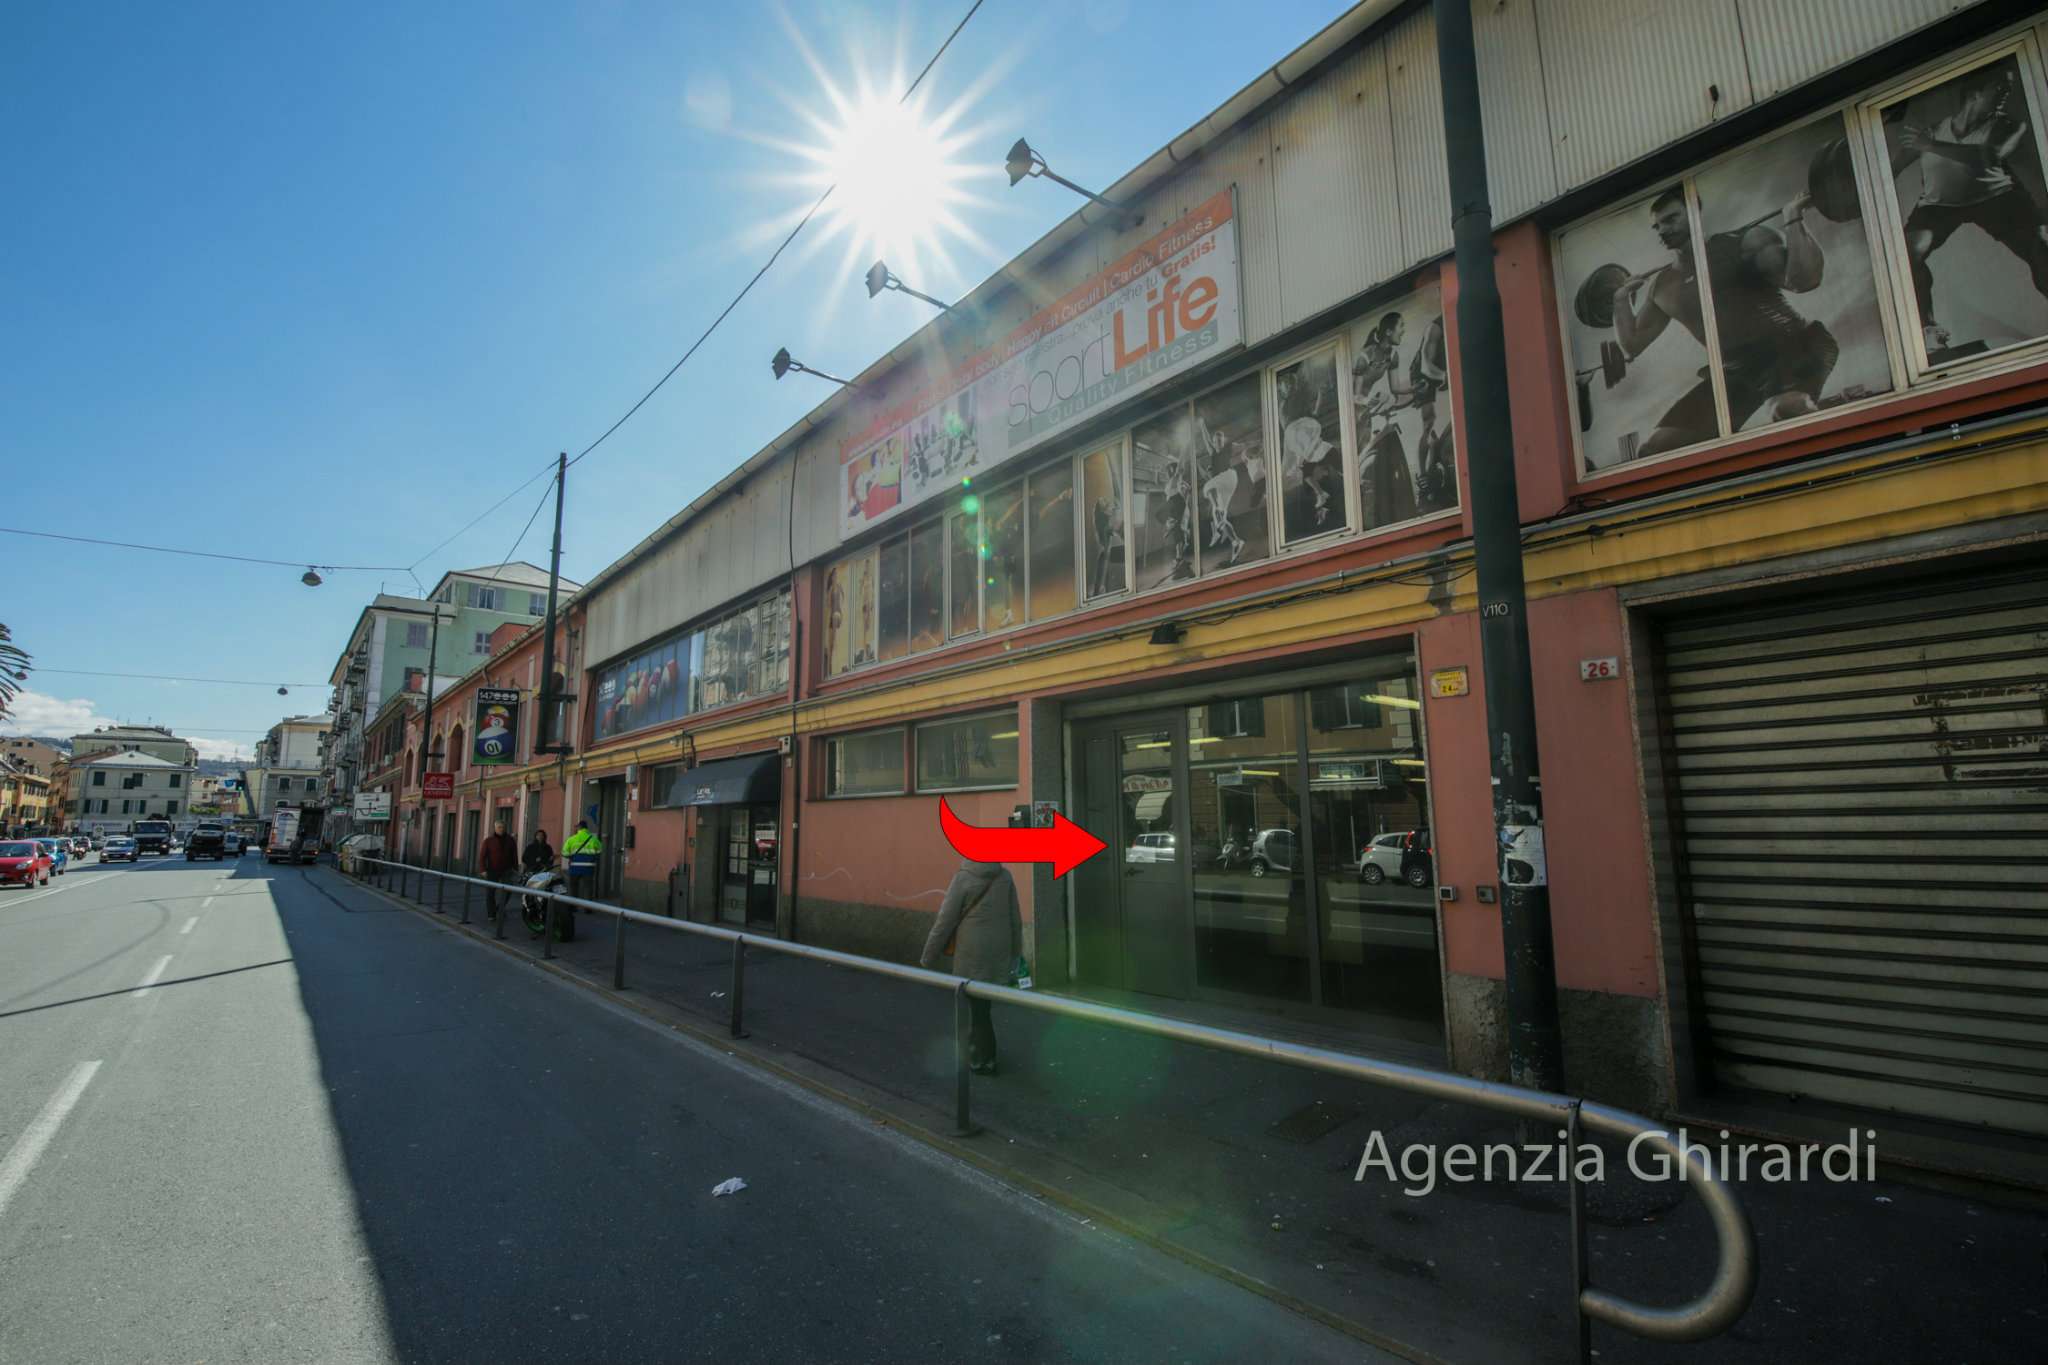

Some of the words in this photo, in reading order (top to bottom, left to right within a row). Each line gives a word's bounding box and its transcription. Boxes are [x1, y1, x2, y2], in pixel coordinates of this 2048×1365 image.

[1110, 254, 1153, 290] Cardio
[1158, 215, 1213, 262] Fitness
[1161, 234, 1217, 279] Gratis!
[1124, 330, 1213, 383] Fitness
[1588, 662, 1609, 678] 26
